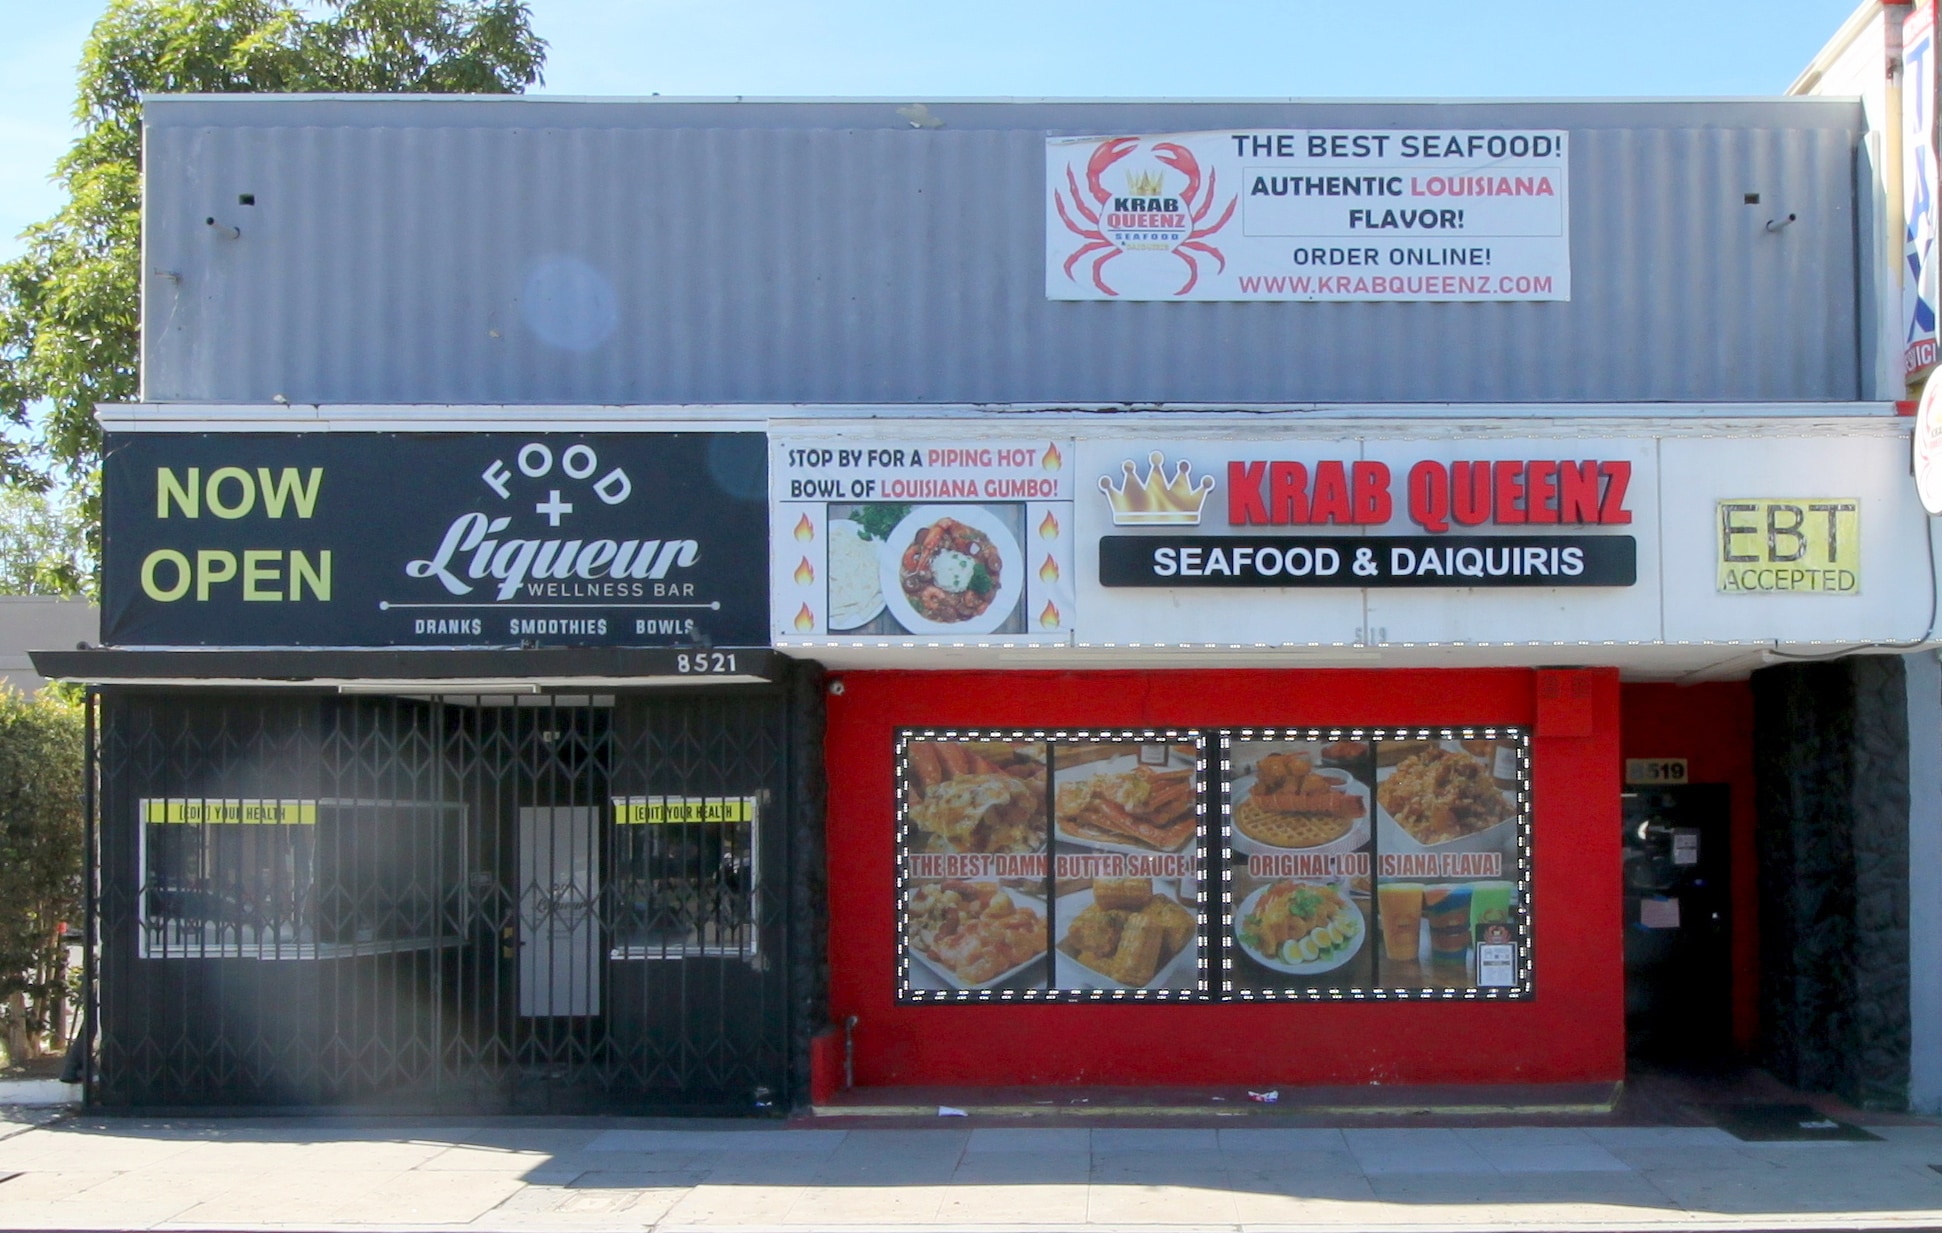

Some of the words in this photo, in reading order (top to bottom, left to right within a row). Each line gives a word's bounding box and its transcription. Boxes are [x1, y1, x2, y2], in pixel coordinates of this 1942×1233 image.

[1232, 135, 1295, 158] THE
[1307, 135, 1391, 158] BEST
[1401, 134, 1562, 158] SEAFOOD!
[1251, 175, 1403, 197] AUTHENTIC
[1410, 175, 1554, 197] LOUISIANA
[1114, 198, 1179, 212] KRAB
[1107, 213, 1185, 229] QUEENZ
[1349, 209, 1464, 230] FLAVOR!
[1115, 233, 1179, 241] SEAFOOD
[1293, 248, 1380, 267] ORDER
[1389, 248, 1492, 267] ONLINE!
[1238, 275, 1553, 296] WWW.KRABQUEENZ.COM
[788, 449, 833, 468] STOP
[838, 449, 862, 468] BY
[867, 449, 905, 468] FOR
[910, 449, 923, 468] A
[928, 449, 992, 468] PIPING
[997, 449, 1036, 468] HOT
[481, 442, 632, 505] FOOD
[156, 466, 325, 520] NOW
[790, 479, 846, 498] BOWL
[851, 479, 876, 498] OF
[880, 479, 979, 498] LOUISIANA
[984, 478, 1059, 498] GUMBO!
[1227, 460, 1393, 525] KRAB
[1408, 460, 1632, 533] QUEENZ
[1722, 504, 1856, 563] EBT
[405, 511, 702, 601] Liqueur
[1153, 547, 1341, 577] SEAFOOD
[1352, 546, 1379, 577] &
[1390, 547, 1585, 579] DAIQUIRIS
[140, 548, 332, 602] OPEN
[1723, 569, 1856, 591] ACCEPTED
[527, 583, 644, 597] WELLNESS
[653, 583, 695, 597] BAR
[677, 653, 737, 673] 8521
[666, 806, 692, 819] YOUR
[696, 805, 732, 819] HEALTH
[912, 856, 942, 877] THE
[947, 856, 993, 877] BEST
[997, 856, 1049, 877] DAMN
[1057, 856, 1123, 878] BUTTER
[1251, 855, 1331, 877] ORIGINAL
[1443, 854, 1501, 876] FLAVA!
